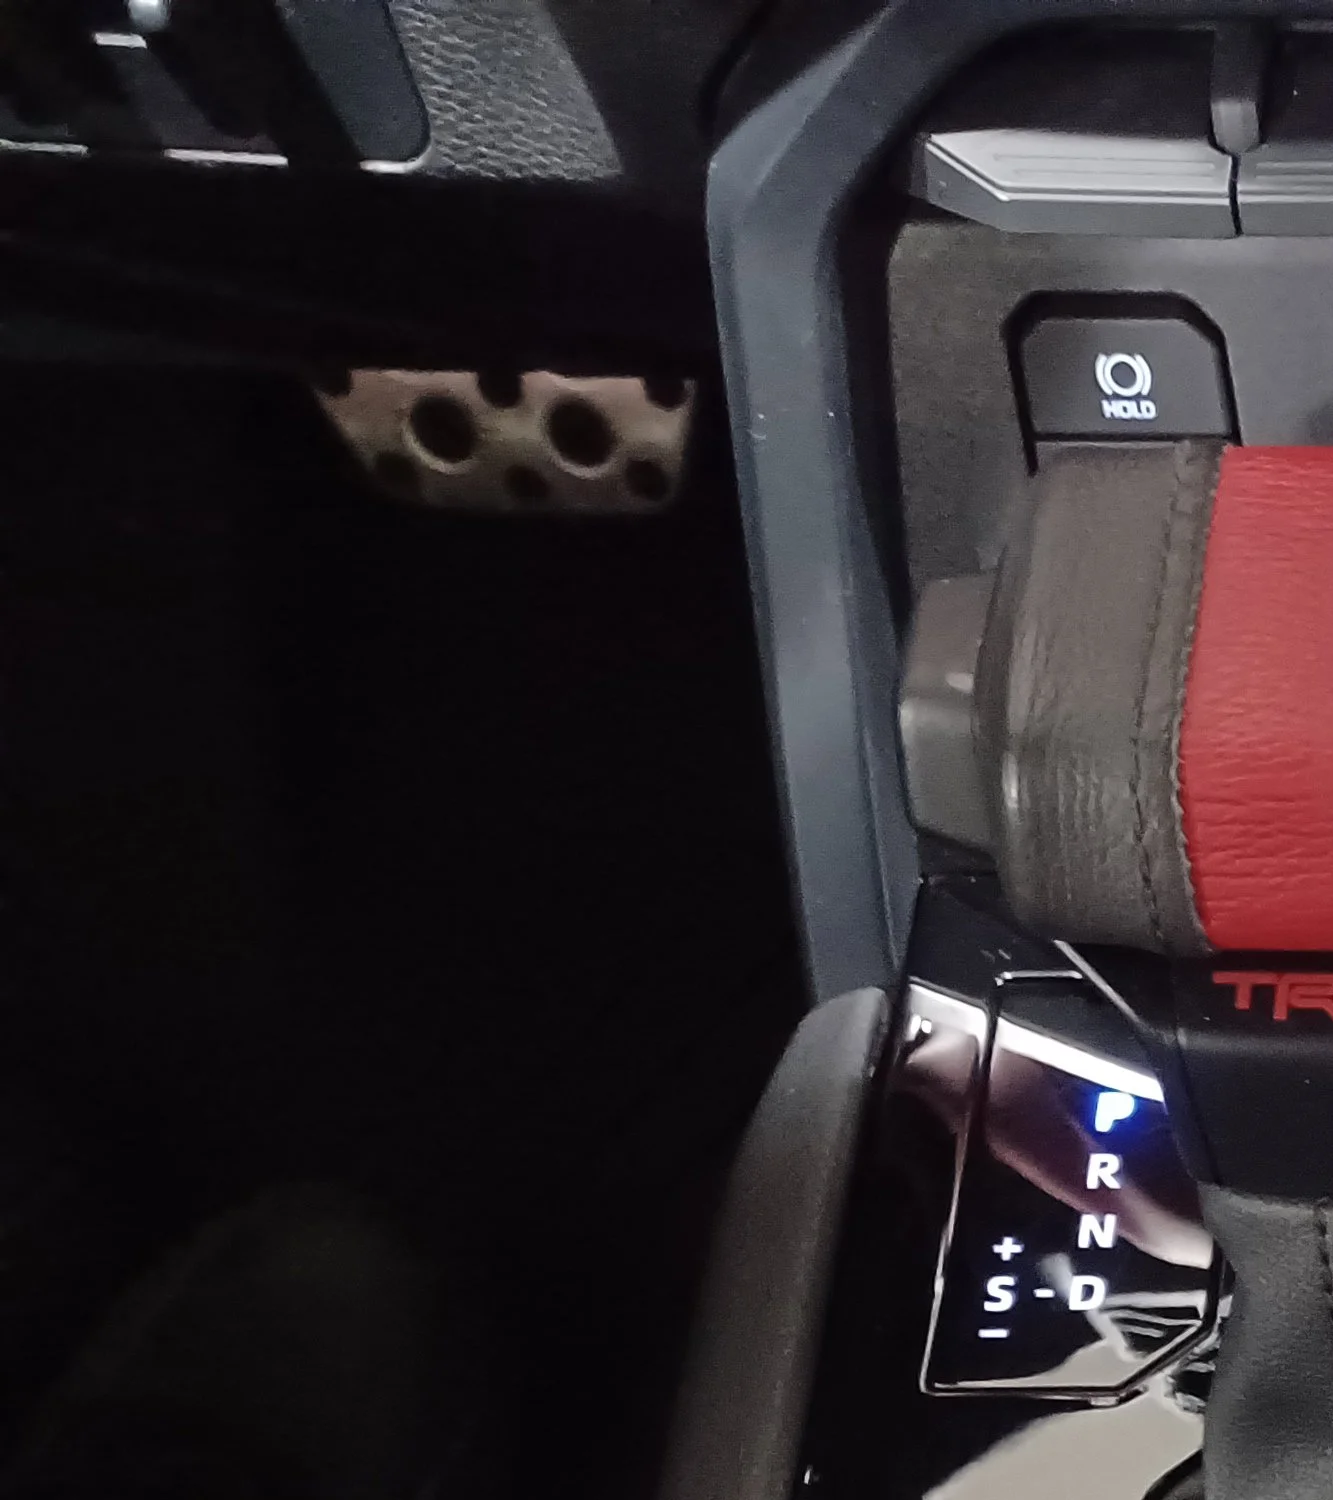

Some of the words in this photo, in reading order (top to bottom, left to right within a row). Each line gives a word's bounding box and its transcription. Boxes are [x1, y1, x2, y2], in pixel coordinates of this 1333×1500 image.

[1101, 399, 1157, 419] HOLD
[1094, 1091, 1135, 1132] P
[1086, 1153, 1120, 1190] R
[1077, 1213, 1118, 1249] N
[983, 1275, 1016, 1312] S
[1068, 1275, 1106, 1311] D
